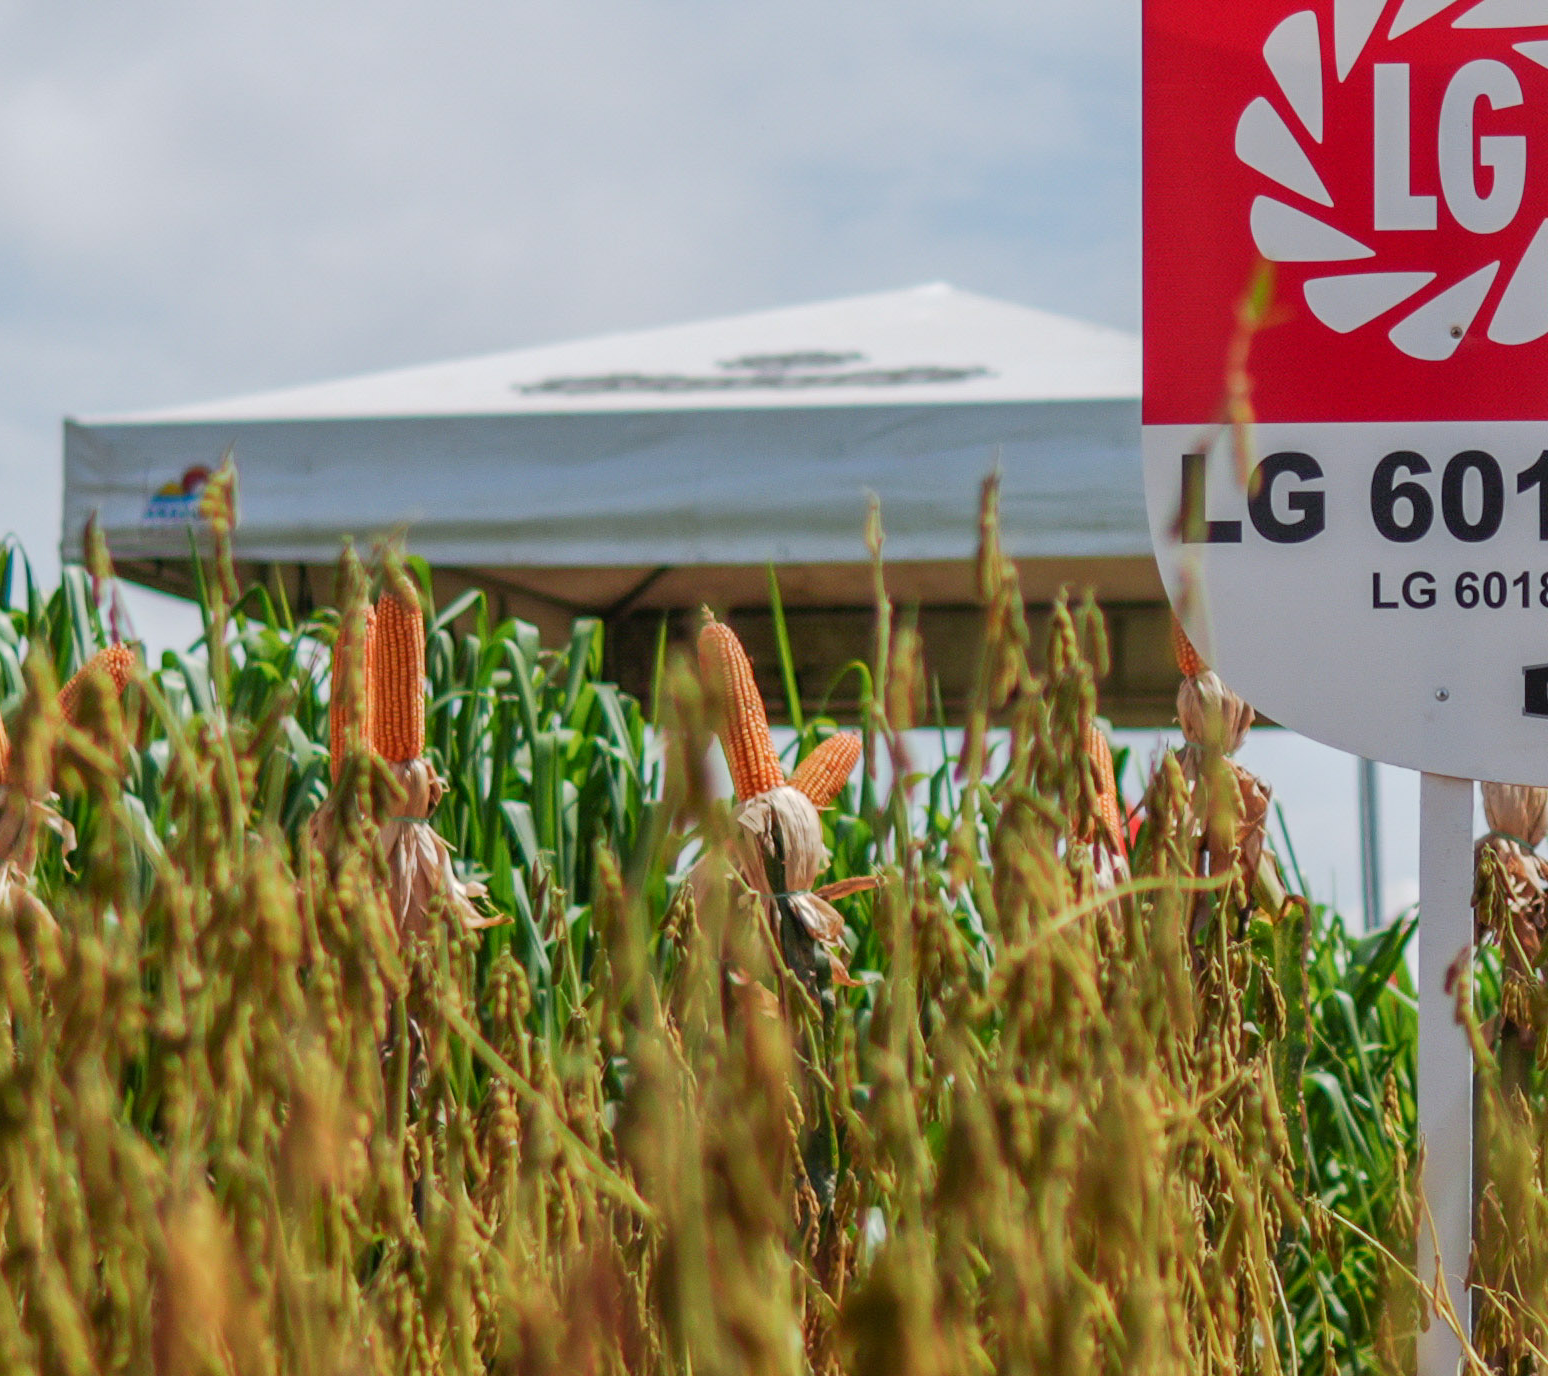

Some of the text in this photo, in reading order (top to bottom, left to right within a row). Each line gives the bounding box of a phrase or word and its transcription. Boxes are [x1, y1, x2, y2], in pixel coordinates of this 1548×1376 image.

[1373, 58, 1528, 235] LG
[1180, 451, 1326, 544] LG
[1372, 570, 1437, 610] LG
